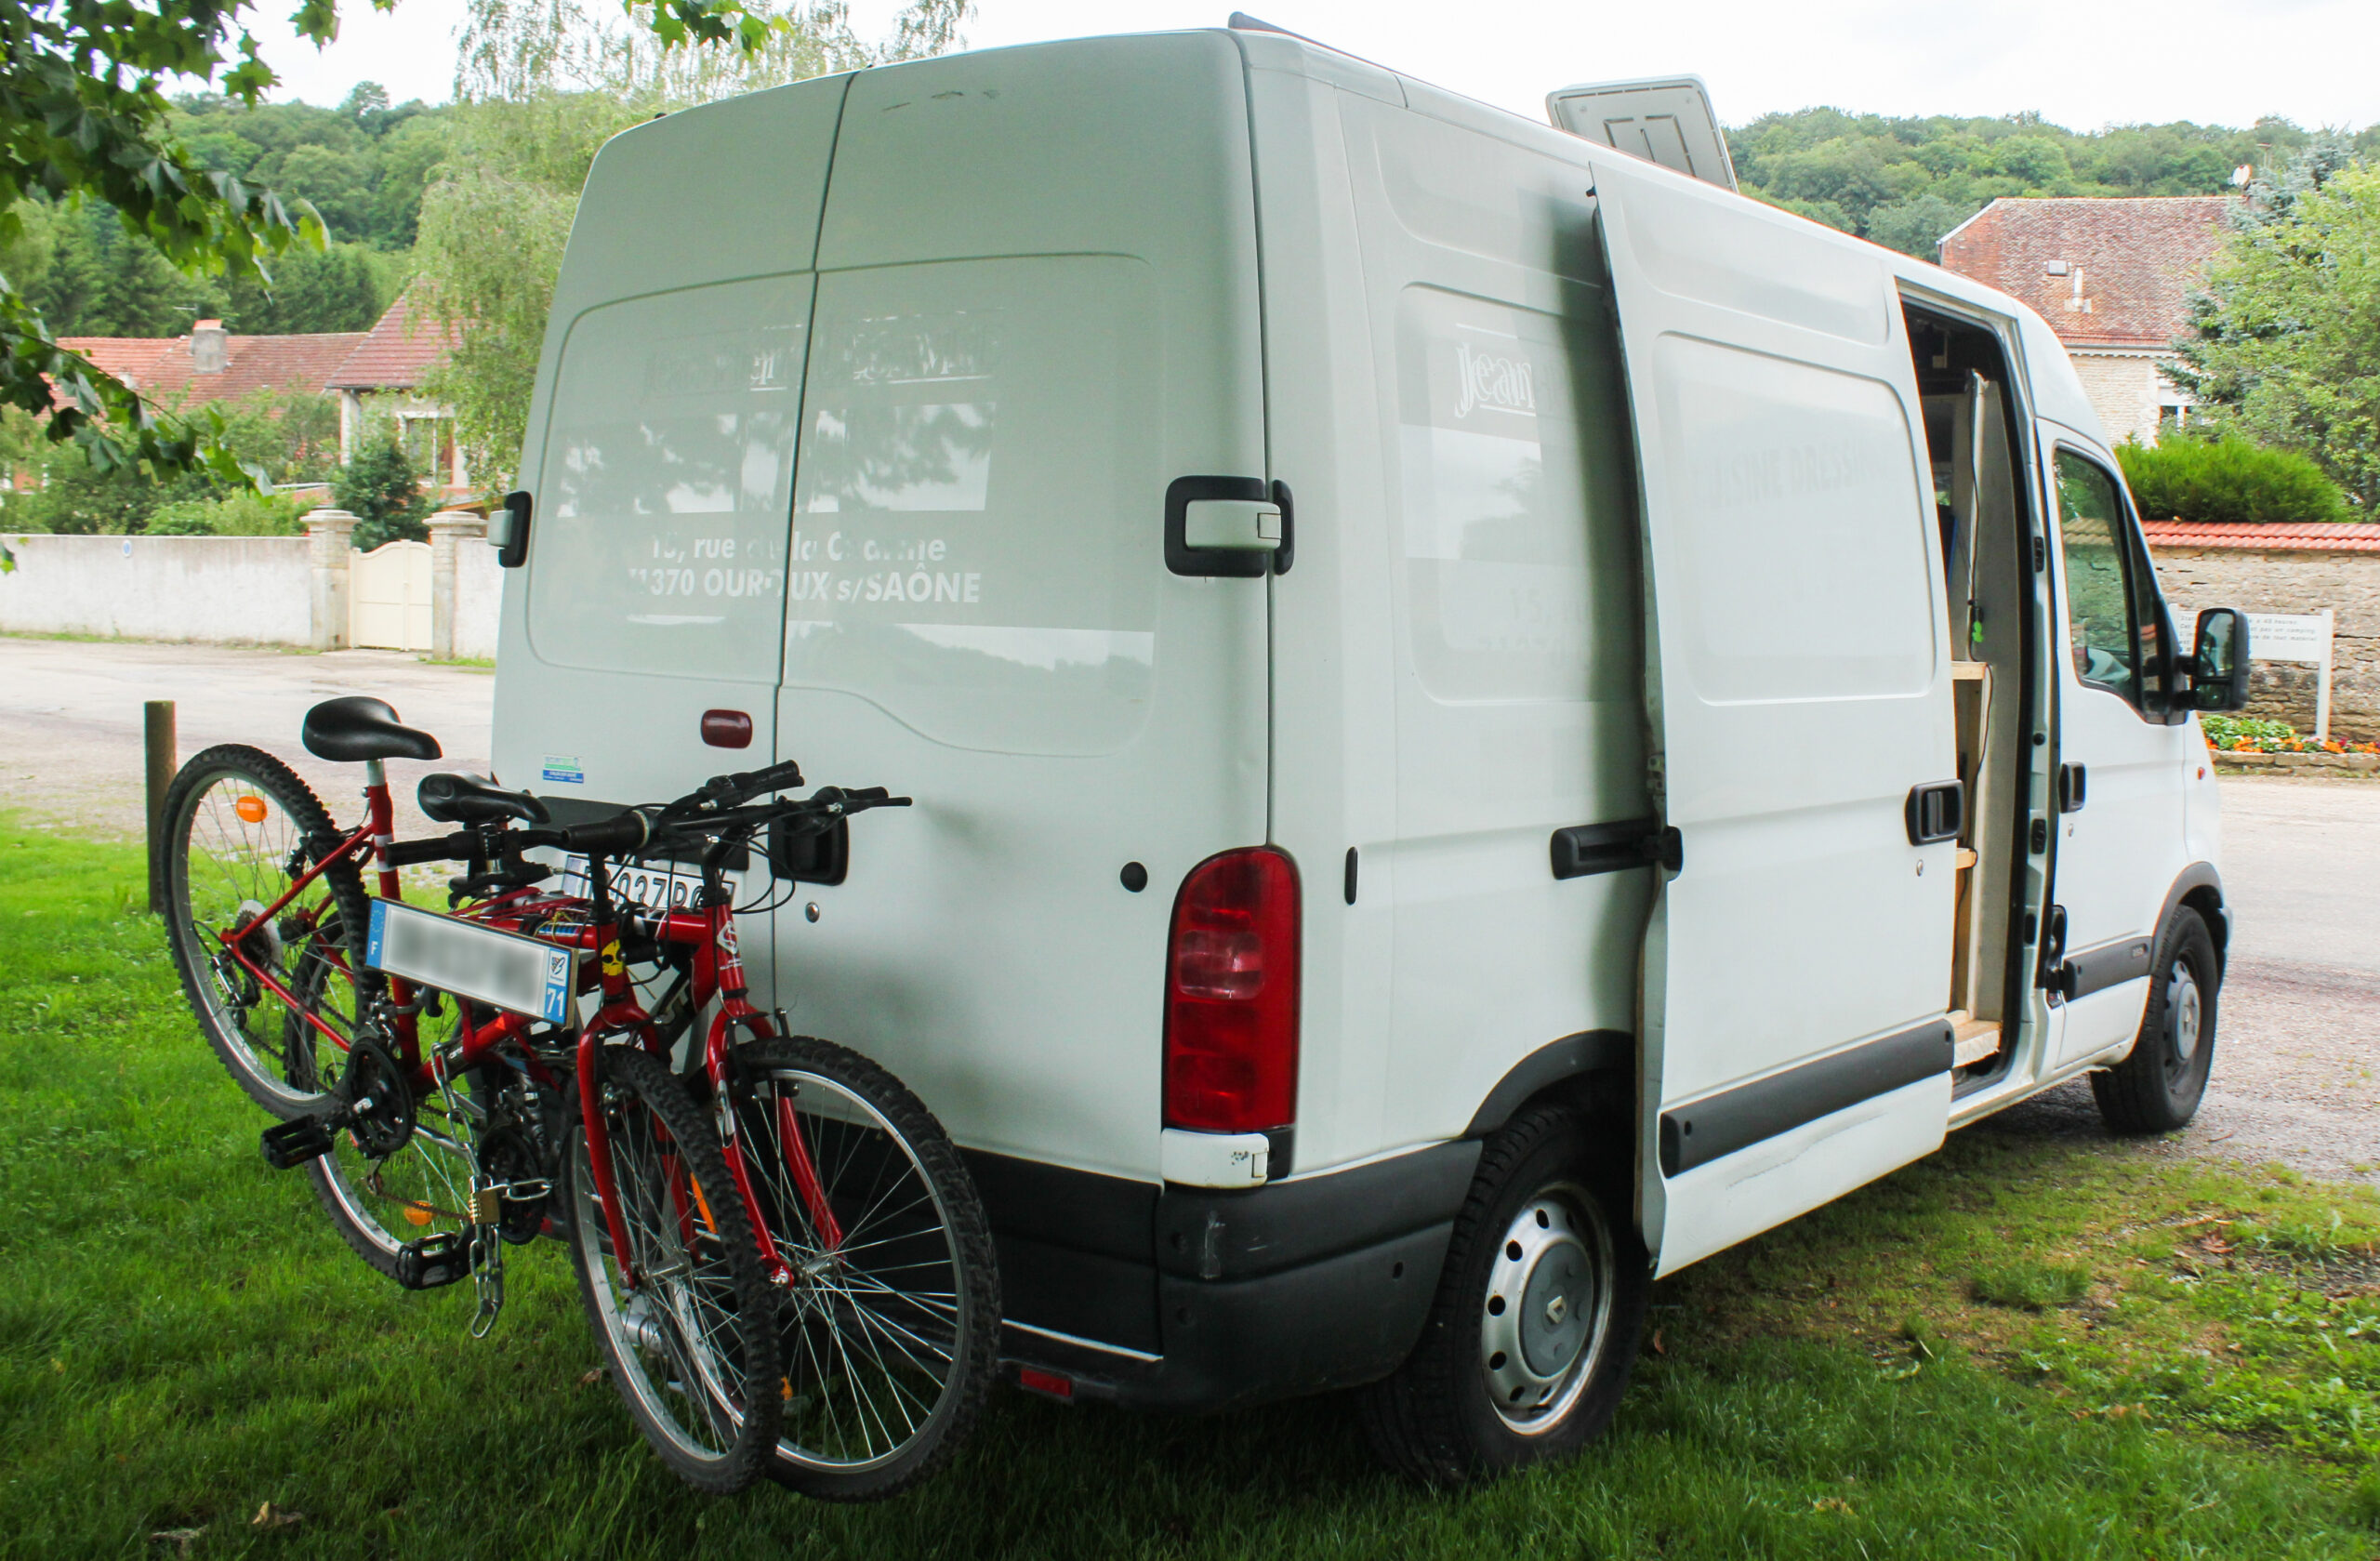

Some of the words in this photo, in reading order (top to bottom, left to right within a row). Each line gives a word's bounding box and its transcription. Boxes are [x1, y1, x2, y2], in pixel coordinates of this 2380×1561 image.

[694, 538, 737, 559] rue
[837, 562, 982, 604] s/SAÔNE
[371, 940, 378, 956] F
[547, 987, 565, 1017] 71
